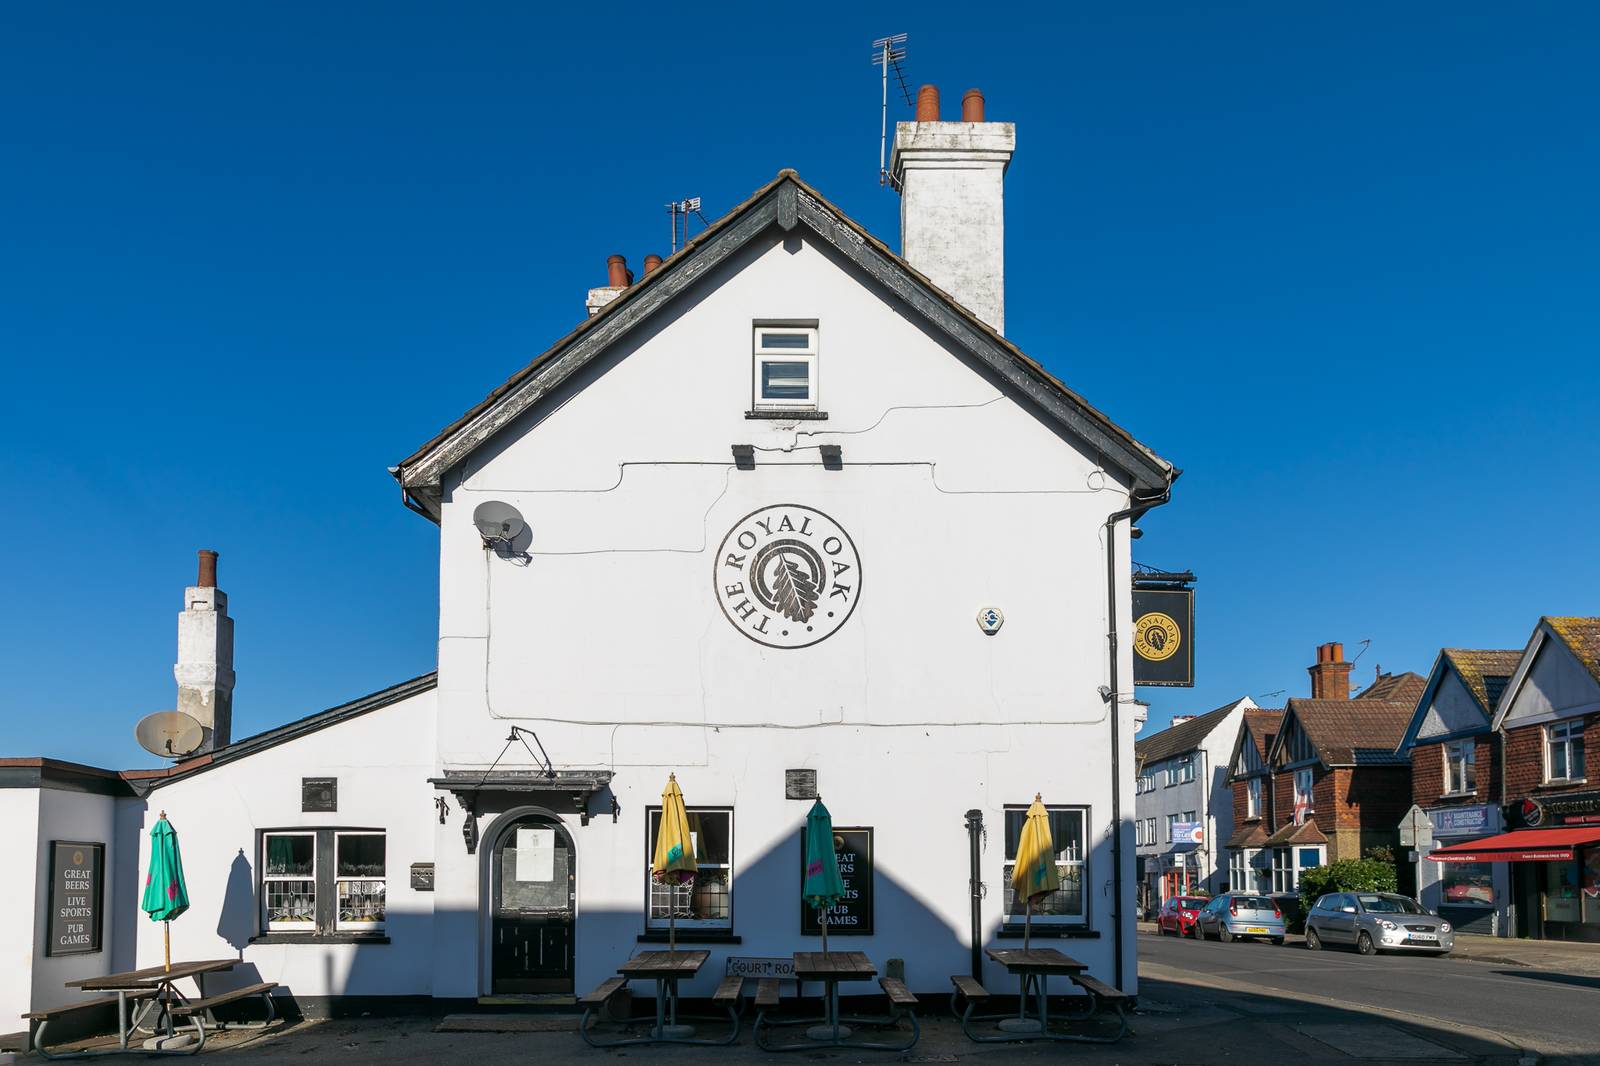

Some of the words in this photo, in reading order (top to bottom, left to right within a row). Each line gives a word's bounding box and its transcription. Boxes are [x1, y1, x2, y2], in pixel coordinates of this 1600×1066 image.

[725, 514, 813, 571] ROYAL
[823, 536, 851, 602] OAK
[725, 581, 771, 635] THE
[1137, 618, 1164, 635] ROYAL
[1167, 624, 1176, 645] OAK
[1137, 638, 1152, 654] THE
[835, 853, 856, 862] EAT
[64, 869, 91, 879] GREAT
[65, 881, 90, 890] BEERS
[67, 897, 86, 906] LIVE
[60, 907, 92, 918] SPORTS
[827, 905, 849, 914] PUB
[817, 916, 858, 925] GAMES
[67, 924, 84, 933] PUB
[60, 934, 90, 945] GAMES
[731, 962, 769, 973] COURT
[775, 963, 796, 974] ROA
